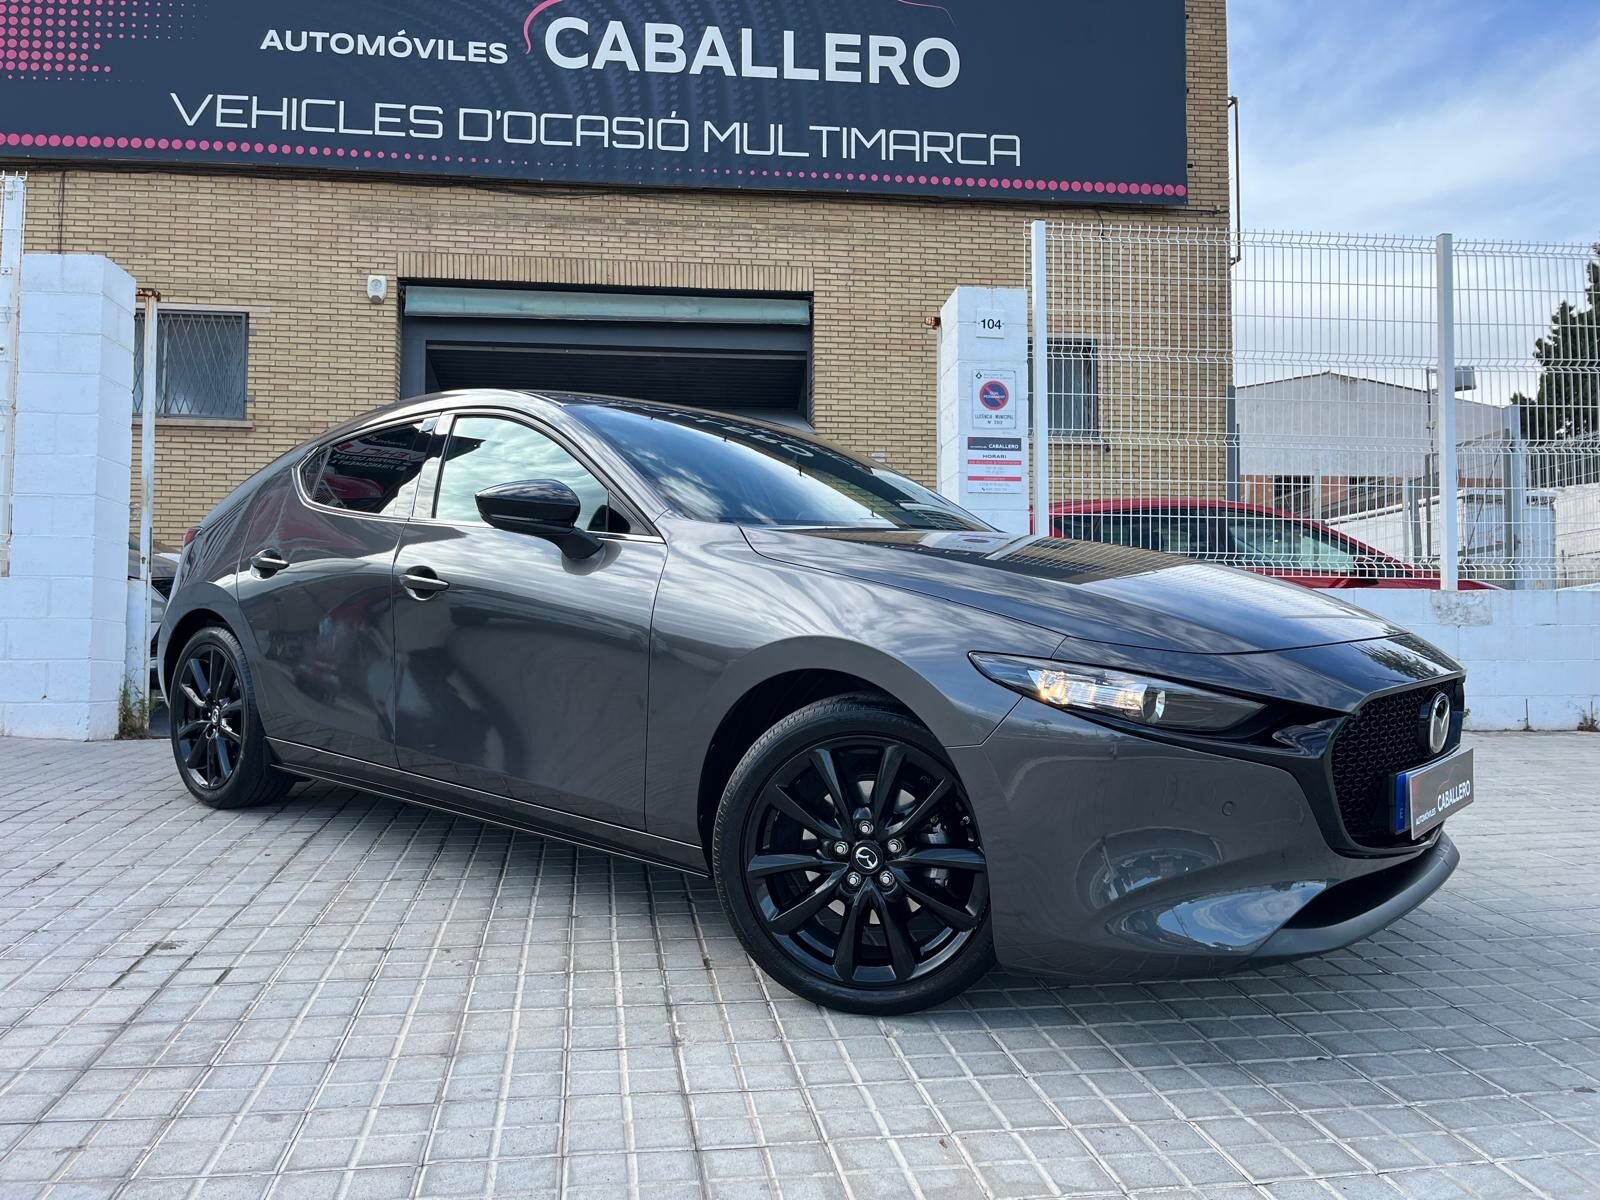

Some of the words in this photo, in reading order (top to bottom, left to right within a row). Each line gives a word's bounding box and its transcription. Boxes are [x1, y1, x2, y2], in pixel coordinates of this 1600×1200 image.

[259, 29, 509, 65] AUTOMÓVILES
[544, 16, 961, 89] CABALLERO
[170, 92, 444, 139] VEHICLES
[458, 107, 690, 152] D'OCASIÓ
[703, 120, 1021, 167] MULTIMARCA
[981, 318, 1001, 330] 104
[1437, 779, 1471, 812] CABALLERO
